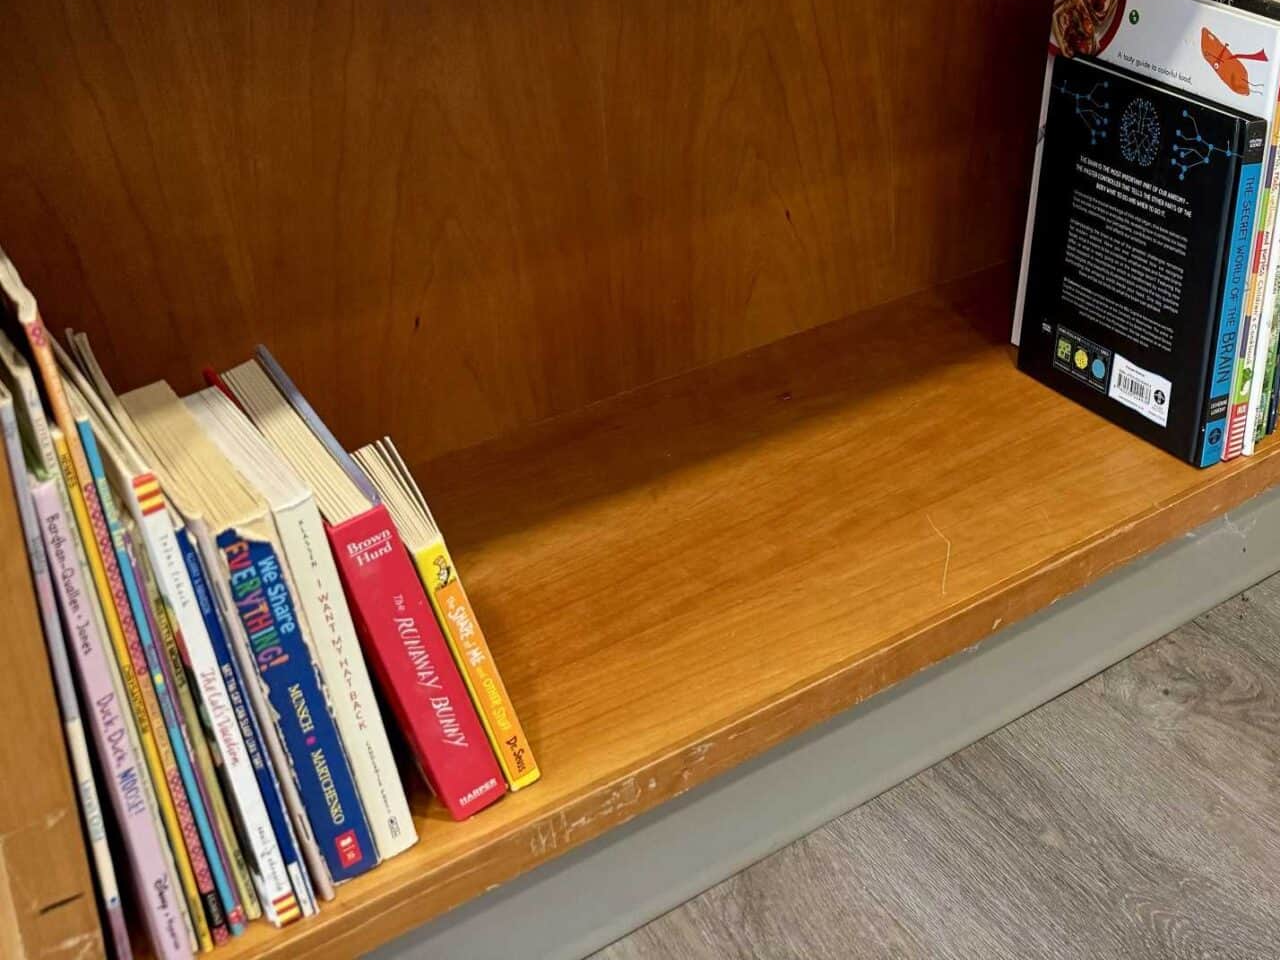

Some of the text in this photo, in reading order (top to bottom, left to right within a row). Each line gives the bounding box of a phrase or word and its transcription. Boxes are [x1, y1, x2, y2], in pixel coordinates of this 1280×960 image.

[1217, 175, 1255, 384] THE SECRET WORLD OF THE BRAIN
[257, 557, 280, 583] We
[346, 529, 391, 555] Brown
[356, 542, 392, 566] Hurd
[223, 541, 289, 672] EVERYTHING!
[446, 605, 476, 641] SHAPE
[317, 592, 337, 634] WANT
[338, 657, 354, 689] HAT
[348, 690, 369, 731] BACK
[392, 593, 468, 749] The RUNAWAY BUNNY
[287, 683, 345, 825] MUNSCH MARTCHENKO
[459, 778, 498, 806] HARPER
